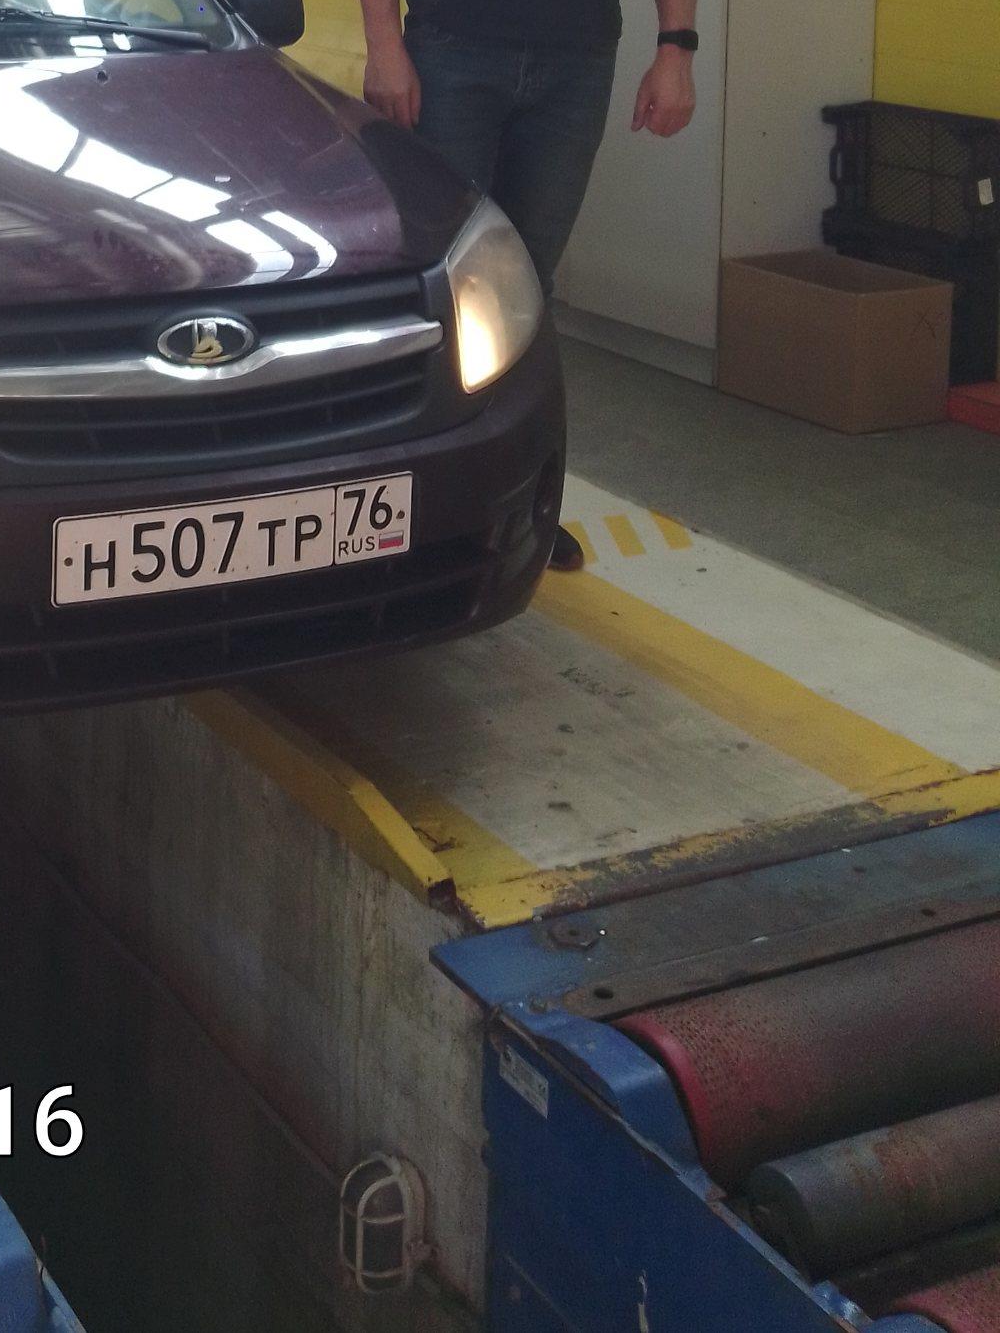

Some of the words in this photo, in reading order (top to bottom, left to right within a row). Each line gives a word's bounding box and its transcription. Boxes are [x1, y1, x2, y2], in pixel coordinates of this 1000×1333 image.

[83, 511, 323, 591] Н507ТР
[342, 485, 393, 537] 76
[338, 535, 376, 558] RUS
